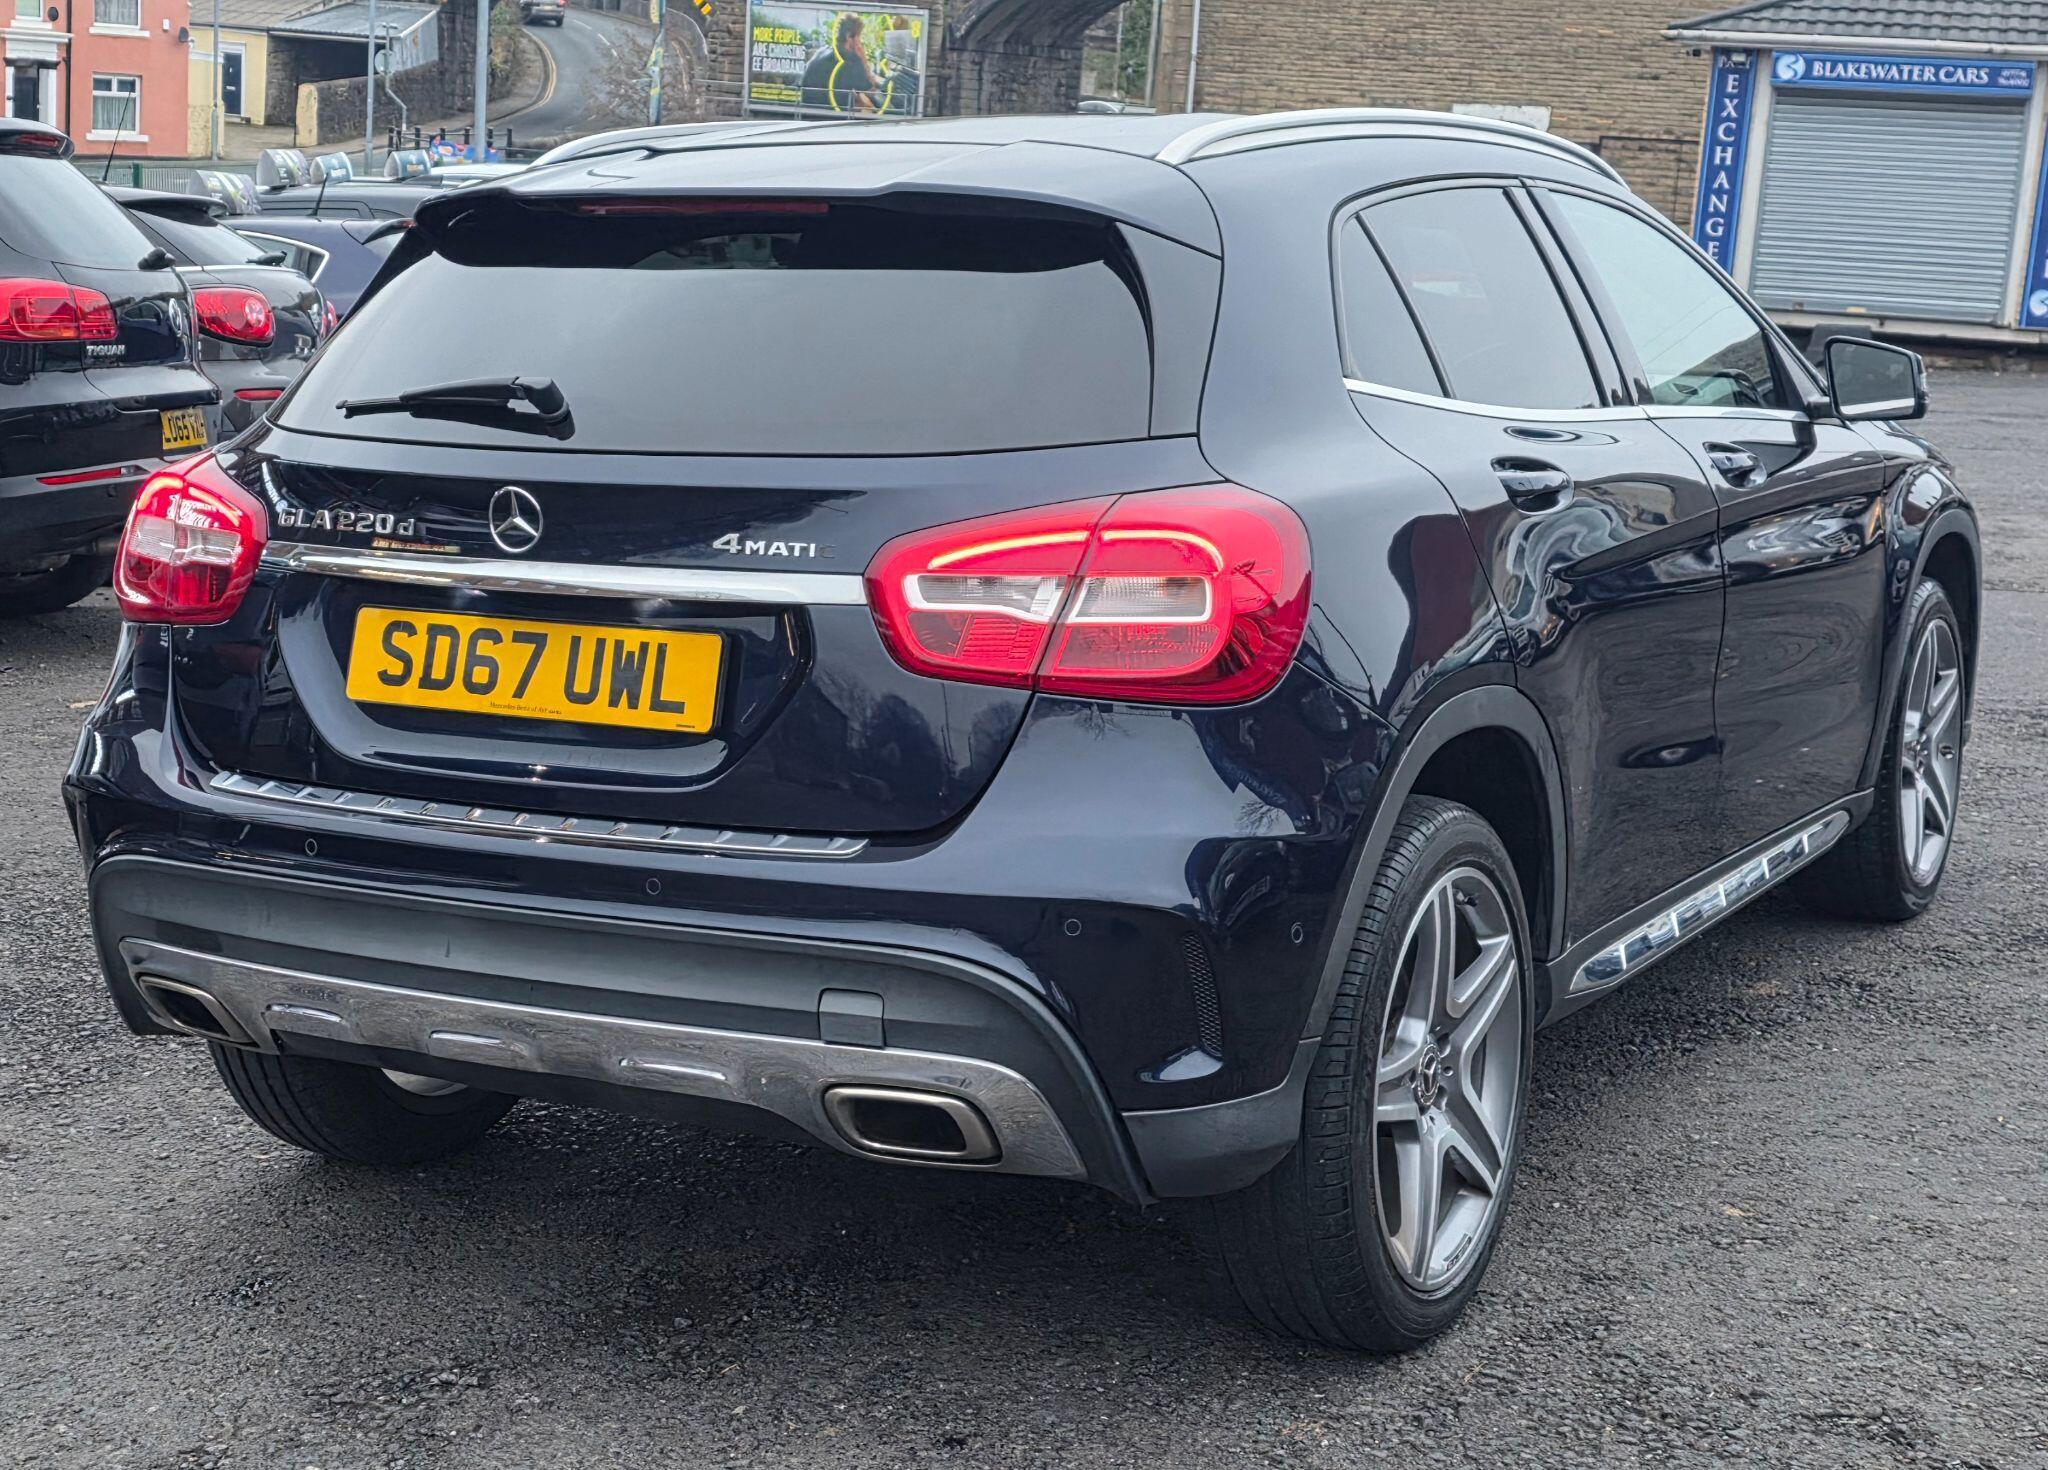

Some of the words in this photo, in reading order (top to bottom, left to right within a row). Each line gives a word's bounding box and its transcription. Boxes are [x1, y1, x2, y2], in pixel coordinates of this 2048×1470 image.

[753, 26, 773, 41] MORE
[774, 28, 801, 44] PEOPLE
[752, 41, 768, 57] ARE
[768, 43, 807, 60] CHOOSING
[752, 56, 763, 71] EE
[1812, 61, 1936, 82] BLAKEWATER
[1939, 65, 1990, 84] CARS
[1705, 74, 1740, 259] EXCHANGE
[86, 344, 125, 356] TIGUAN
[277, 507, 333, 530] GLA
[336, 511, 395, 534] 220
[397, 518, 415, 536] d
[377, 620, 548, 699] SD67
[564, 635, 686, 715] UWL
